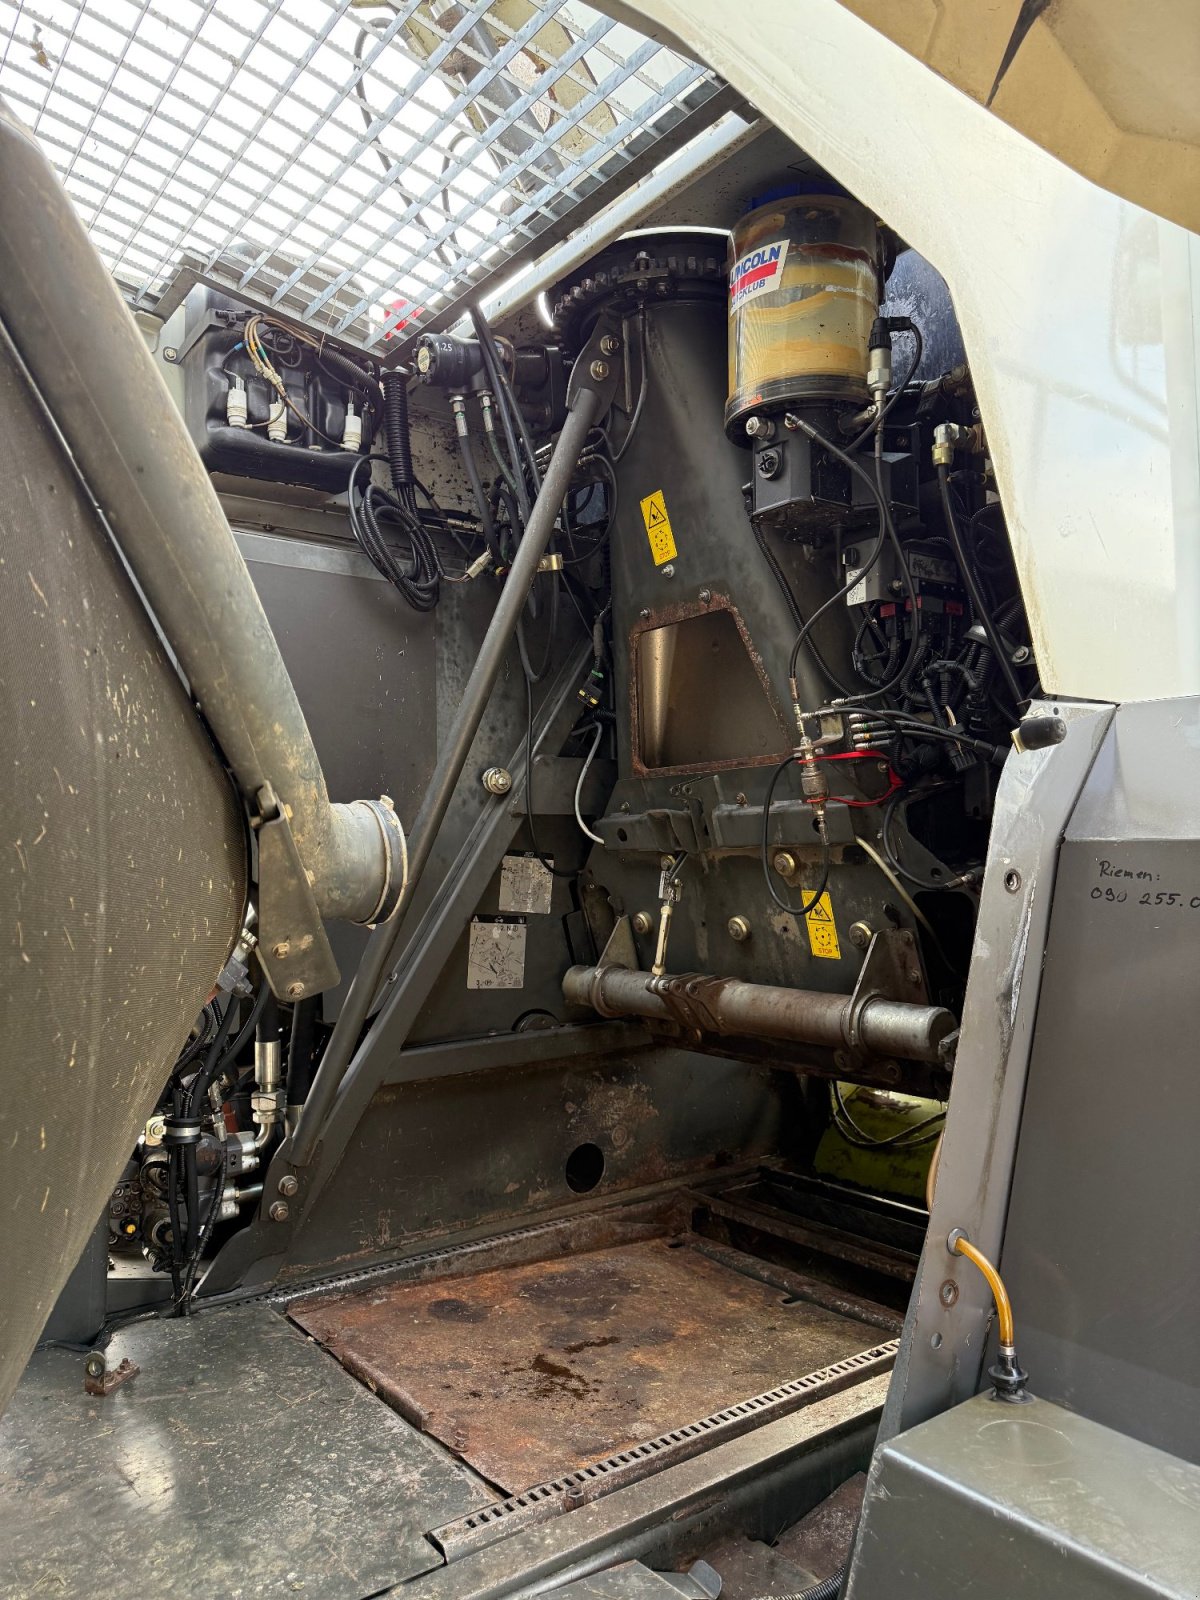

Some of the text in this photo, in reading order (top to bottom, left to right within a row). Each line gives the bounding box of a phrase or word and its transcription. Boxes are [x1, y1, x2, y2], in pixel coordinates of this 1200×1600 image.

[731, 245, 782, 284] LINCOLN
[1099, 860, 1160, 882] Riemen:
[1090, 886, 1128, 903] 090
